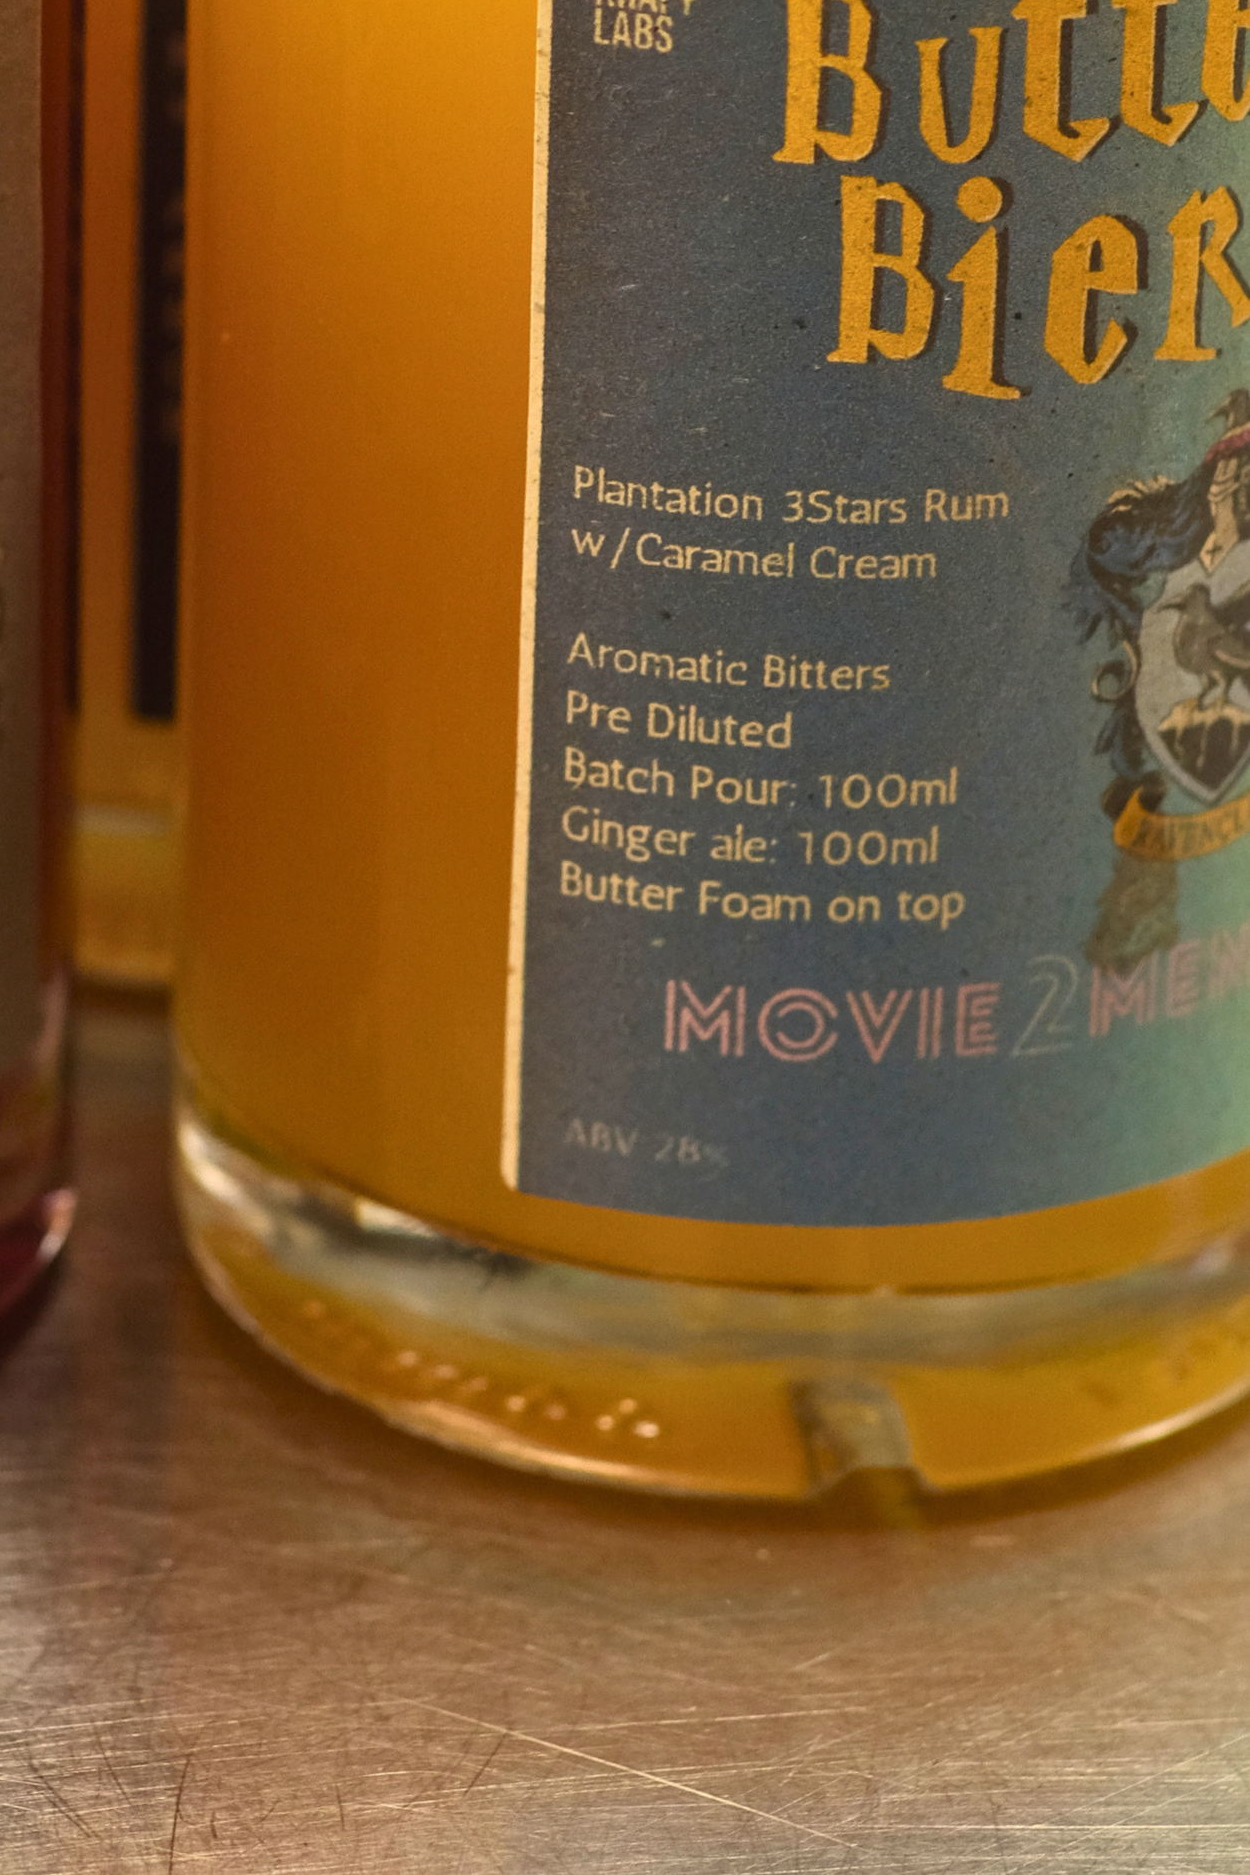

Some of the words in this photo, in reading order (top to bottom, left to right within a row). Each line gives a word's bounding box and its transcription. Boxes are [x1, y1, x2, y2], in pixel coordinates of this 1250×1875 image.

[593, 6, 673, 53] LABS
[573, 464, 764, 522] Plantation
[782, 489, 907, 525] 3Stars
[923, 487, 1010, 523] Rum
[571, 526, 795, 578] w/Caramel
[810, 545, 936, 580] Cream
[566, 631, 748, 686] Aromatic
[763, 653, 891, 691] Bitters
[565, 689, 632, 733] Pre
[647, 702, 793, 750] Diluted
[563, 745, 675, 797] Batch
[690, 764, 796, 808] Pour:
[818, 766, 958, 809] 100ml
[561, 805, 696, 863] Ginger
[709, 823, 777, 865] ale:
[797, 825, 939, 865] 100ml
[559, 859, 684, 912] Butter
[698, 880, 811, 922] Foam
[827, 893, 881, 923] on
[898, 889, 966, 931] top
[563, 1116, 639, 1158] ABV
